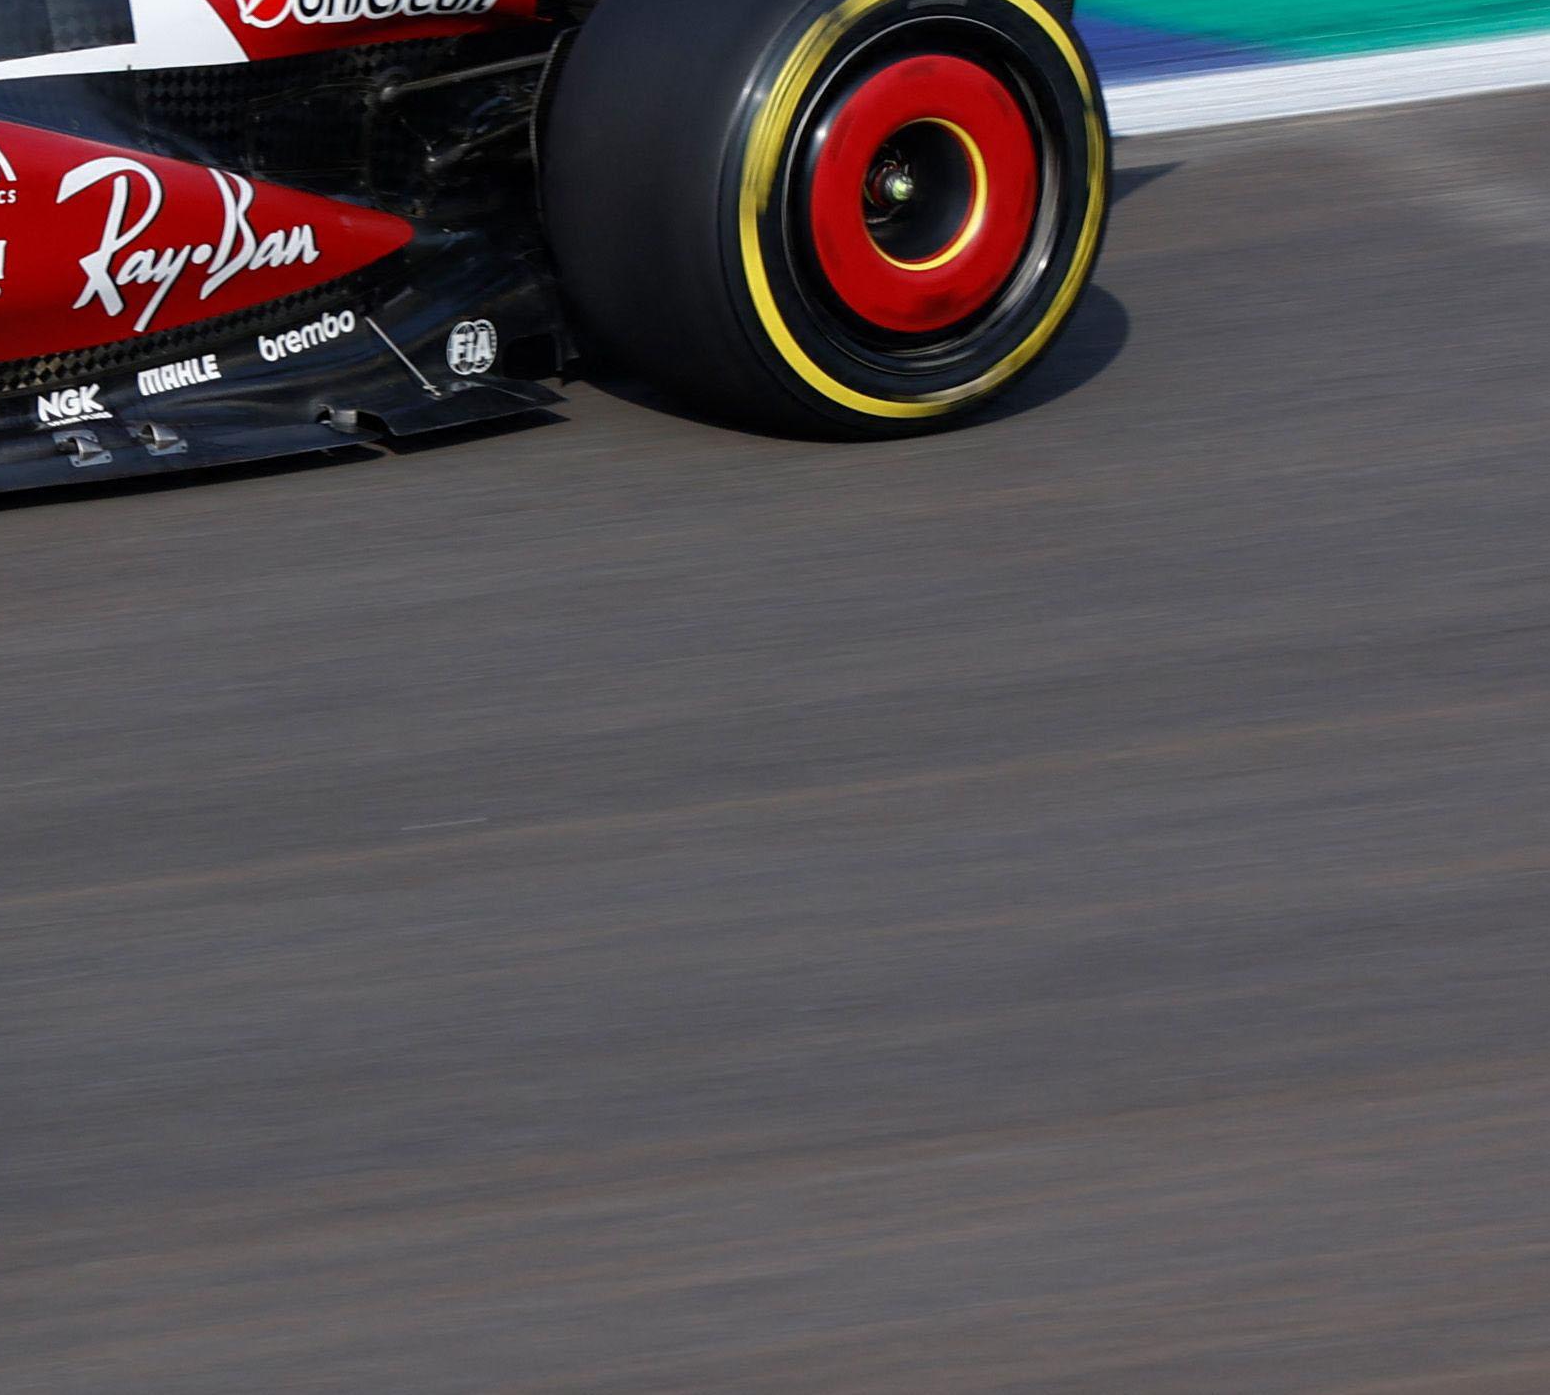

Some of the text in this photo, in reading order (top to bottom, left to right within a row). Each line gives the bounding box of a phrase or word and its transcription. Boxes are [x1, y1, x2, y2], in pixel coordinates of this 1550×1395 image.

[258, 309, 356, 362] brembo
[137, 353, 222, 396] MAHLE
[37, 383, 105, 423] NGK
